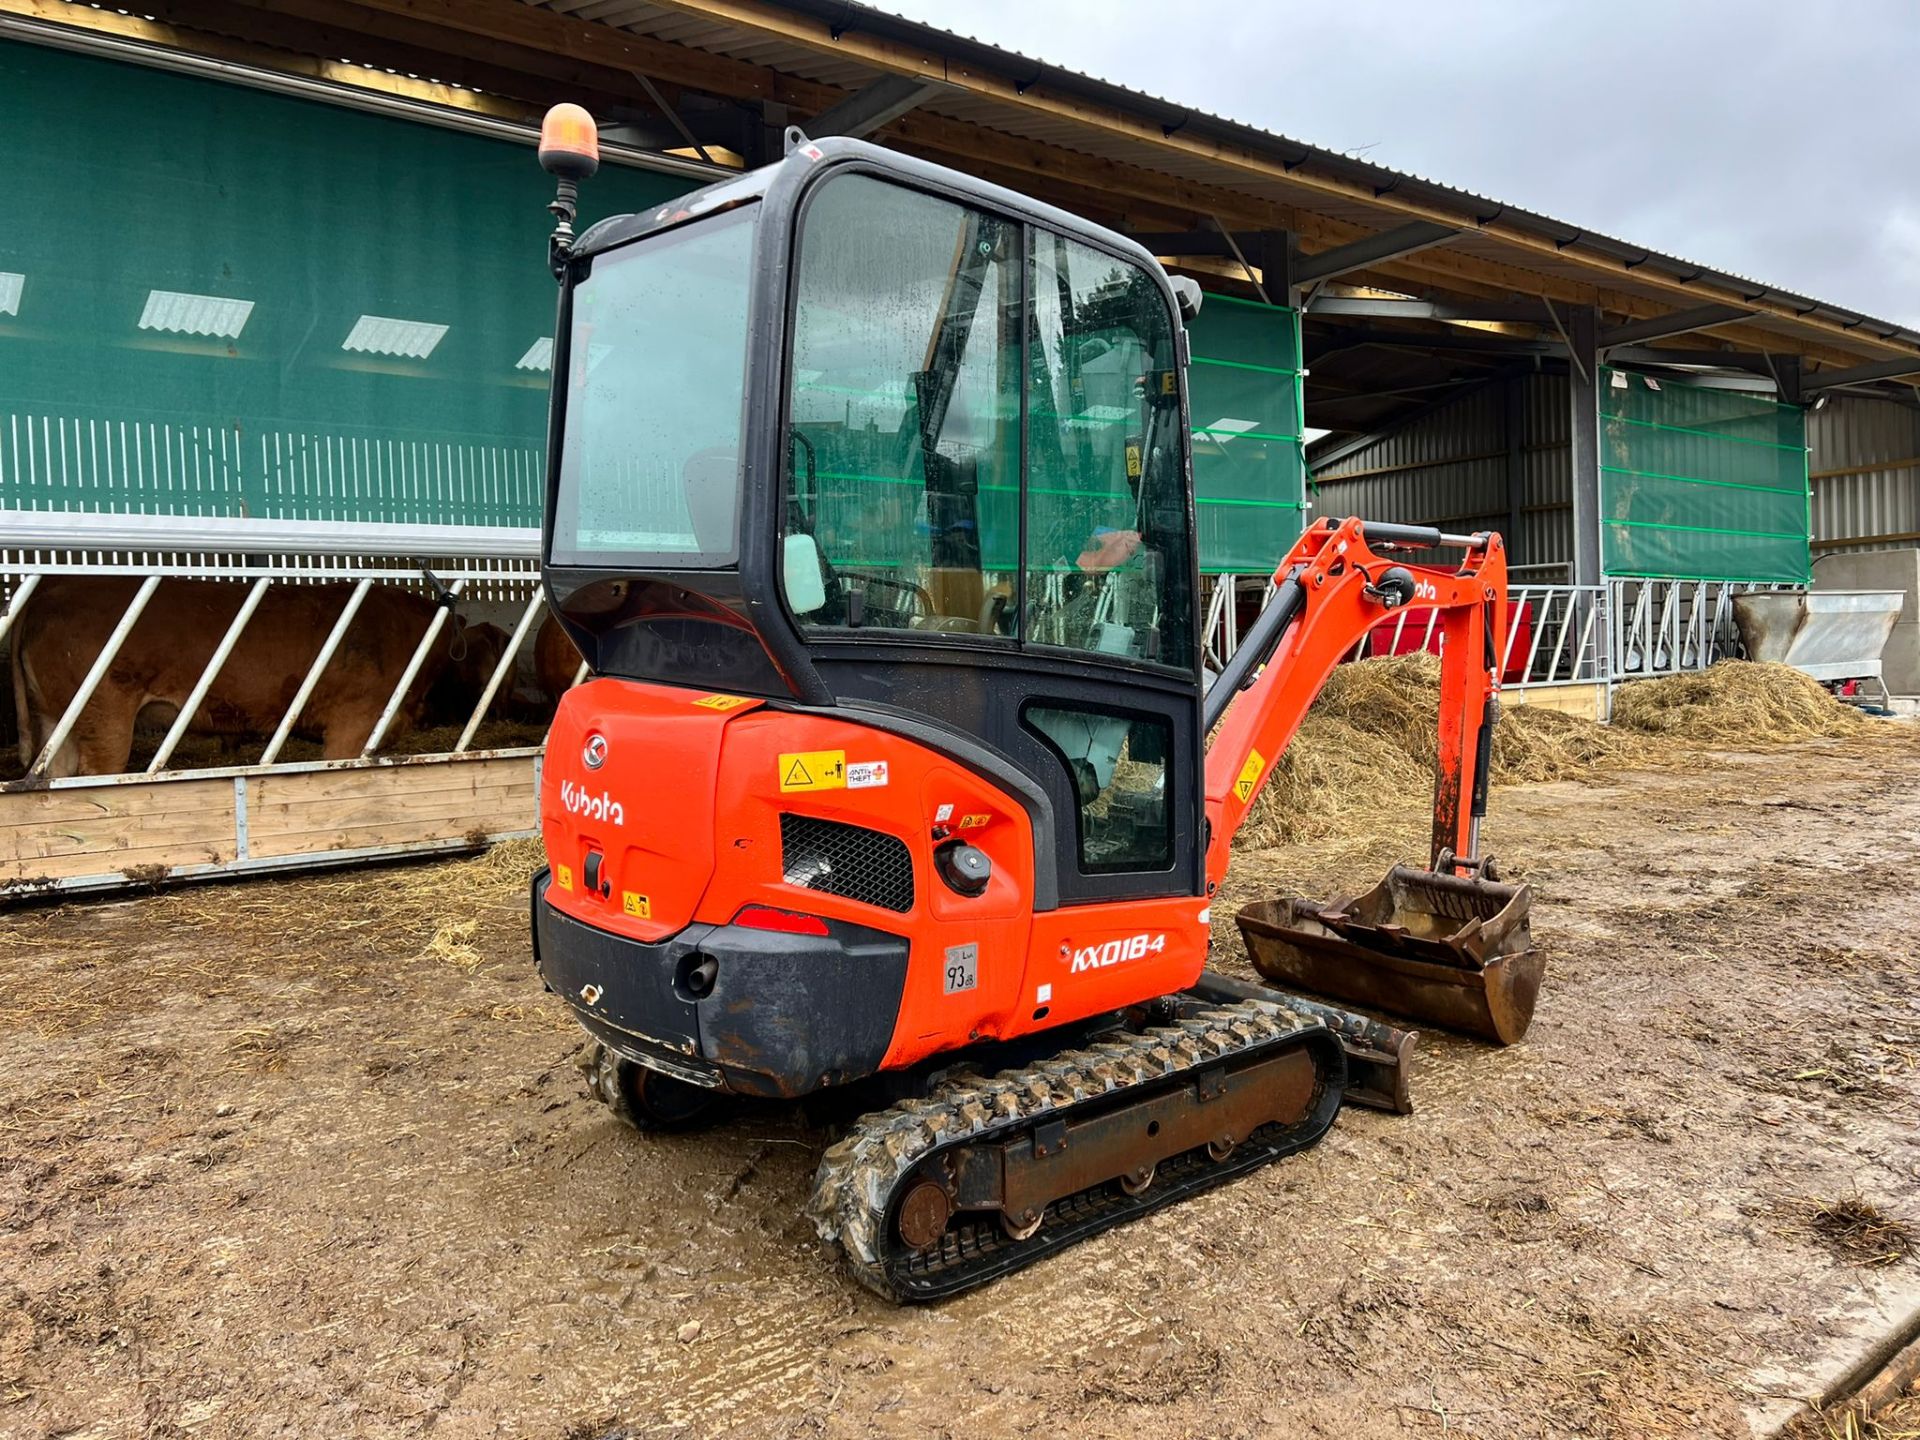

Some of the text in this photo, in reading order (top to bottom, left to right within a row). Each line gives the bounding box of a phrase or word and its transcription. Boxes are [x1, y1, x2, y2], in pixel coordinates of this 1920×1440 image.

[1415, 578, 1436, 600] ota
[849, 774, 871, 782] THEFT
[561, 779, 623, 826] Kubota
[1071, 933, 1165, 974] KX018-4
[947, 965, 965, 989] 93
